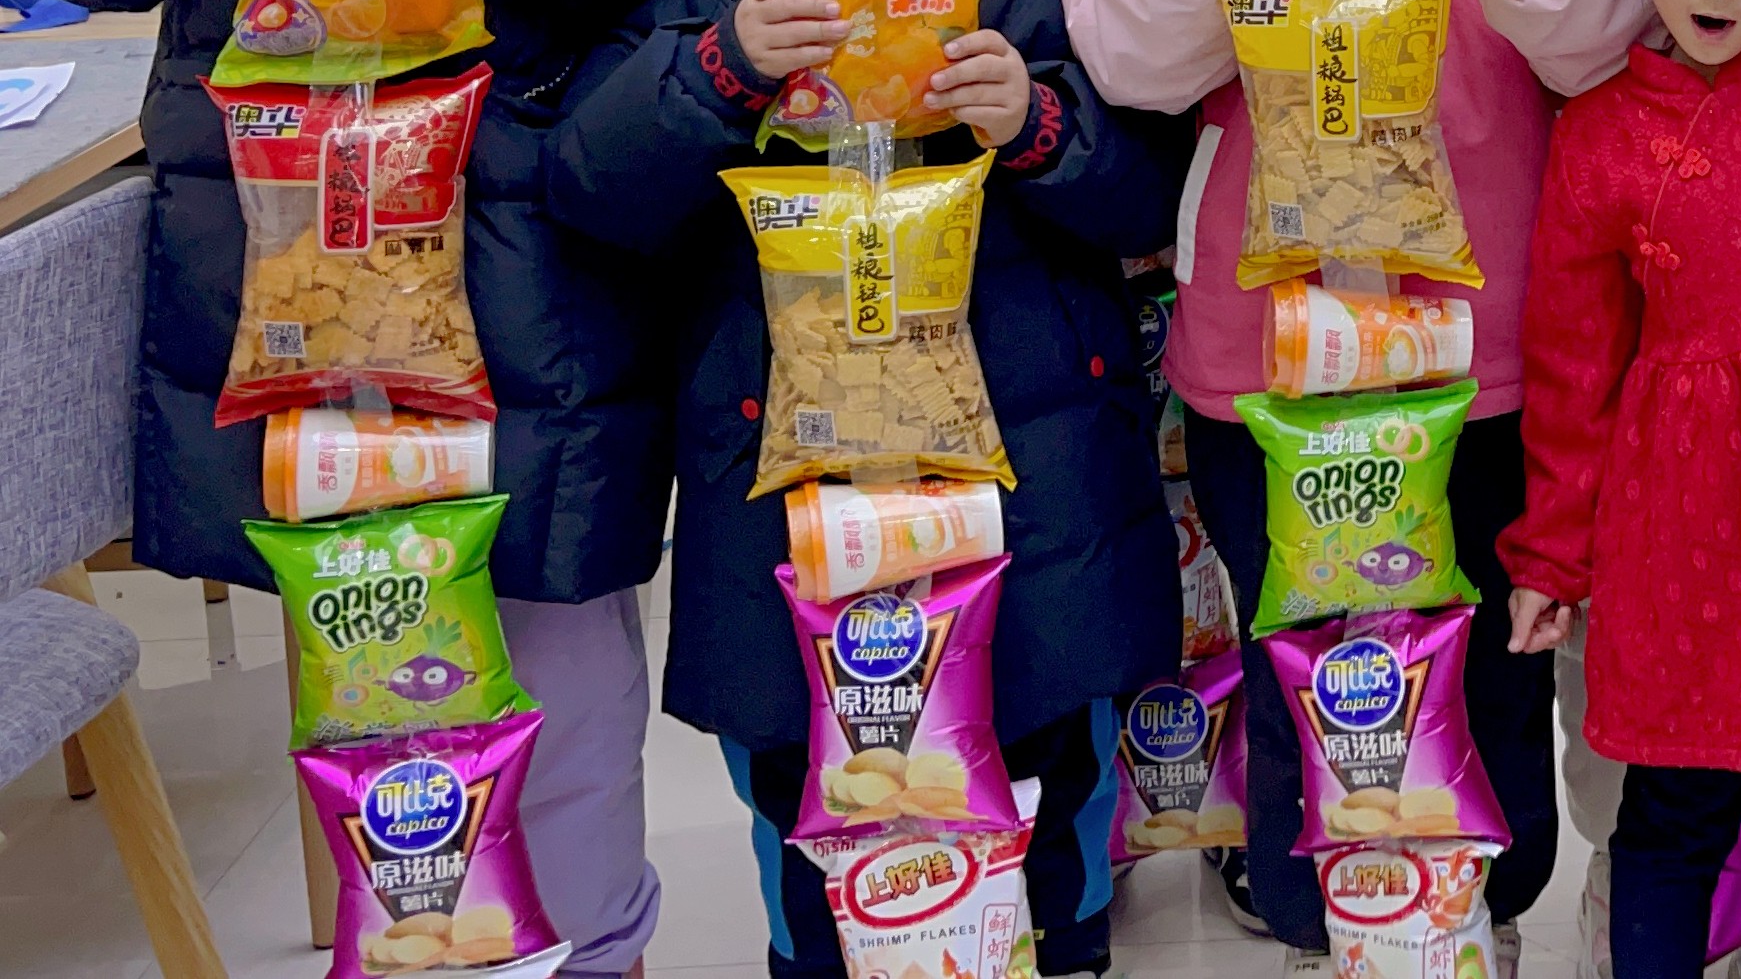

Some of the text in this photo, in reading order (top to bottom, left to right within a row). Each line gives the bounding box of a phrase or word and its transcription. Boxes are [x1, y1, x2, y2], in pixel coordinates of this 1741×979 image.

[1299, 430, 1372, 455] 上好佳
[1309, 483, 1396, 526] rings
[313, 548, 391, 577] 上好佳
[330, 599, 422, 648] rings
[846, 606, 915, 644] 可比克
[1325, 653, 1394, 697] 可比克
[833, 684, 923, 715] 原滋味
[1139, 698, 1198, 735] 可比克
[858, 725, 900, 744] 薯片
[1324, 732, 1407, 762] 原滋味
[1134, 760, 1209, 787] 原滋味
[375, 775, 454, 821] 可比克
[371, 851, 465, 889] 原滋味
[861, 850, 957, 909] 上好佳
[1333, 860, 1409, 897] 上好佳
[400, 892, 443, 912] 薯片
[859, 924, 977, 949] SHRIMP FLAKES
